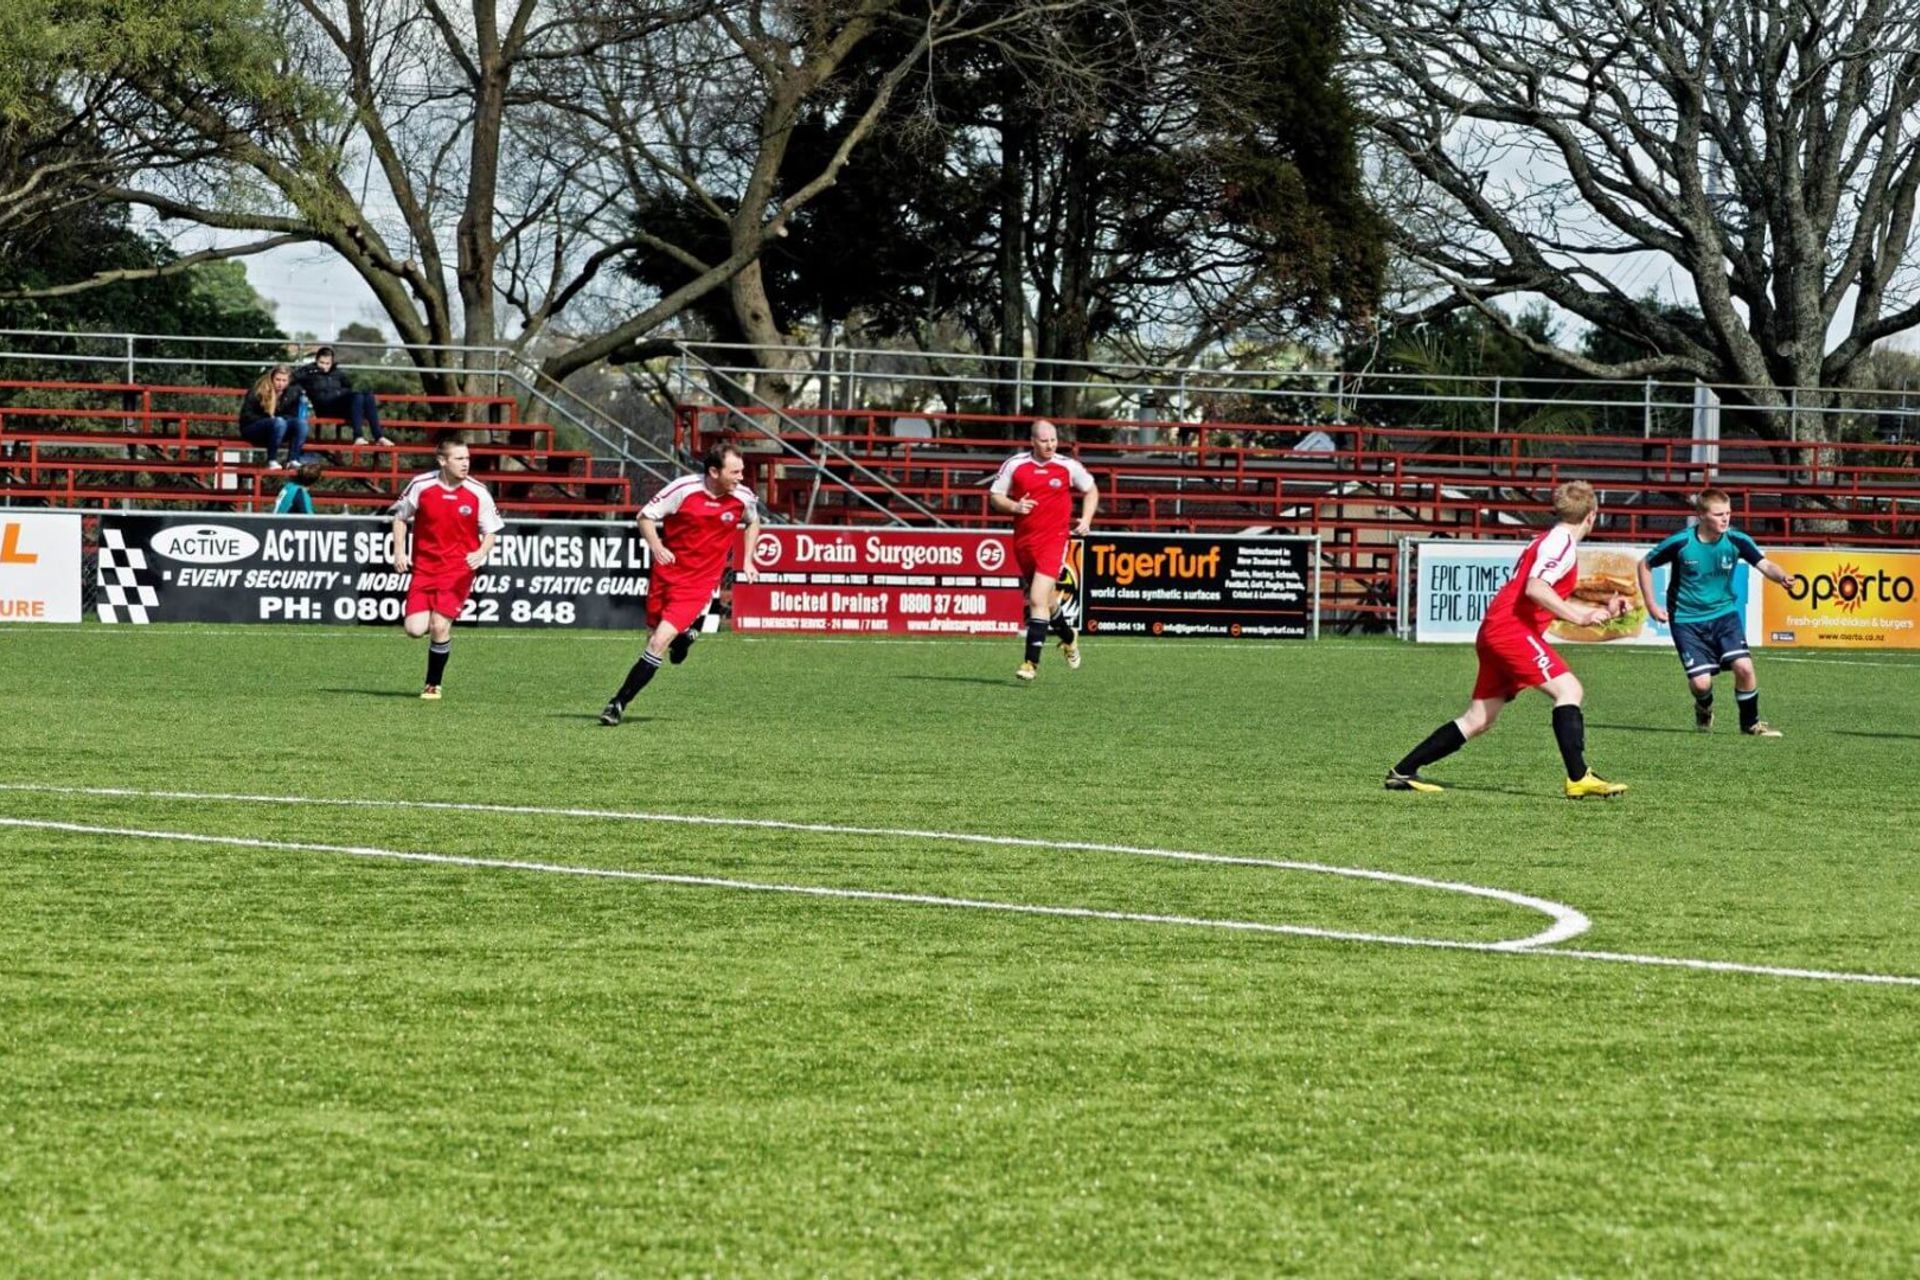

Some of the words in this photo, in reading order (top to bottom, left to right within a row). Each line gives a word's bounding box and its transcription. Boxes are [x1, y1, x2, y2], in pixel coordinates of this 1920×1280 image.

[168, 538, 240, 555] ACTIVE
[262, 529, 348, 563] ACTIVE
[590, 536, 622, 568] NZ
[628, 538, 650, 569] LT
[796, 534, 856, 563] Drain
[865, 536, 963, 570] Surgeons
[1091, 544, 1221, 585] TigerTurf
[1431, 565, 1461, 592] EPIC
[177, 568, 243, 588] EVENT
[244, 569, 340, 590] SECURITY
[356, 572, 412, 592] MOBIL
[529, 575, 594, 595] STATIC
[596, 576, 649, 596] GUAR
[1090, 587, 1115, 598] world
[1117, 587, 1140, 599] class
[1142, 588, 1182, 601] synthetic
[1183, 589, 1221, 600] surfaces
[1788, 569, 1914, 609] oporto
[260, 596, 322, 619] PH:
[333, 597, 407, 620] 080
[456, 599, 499, 621] 22
[510, 600, 576, 624] 848
[770, 591, 828, 612] Blocked
[831, 592, 888, 613] Drains?
[900, 593, 932, 613] 0800
[934, 594, 951, 614] 37
[953, 594, 986, 614] 2000
[1430, 593, 1462, 621] EPIC
